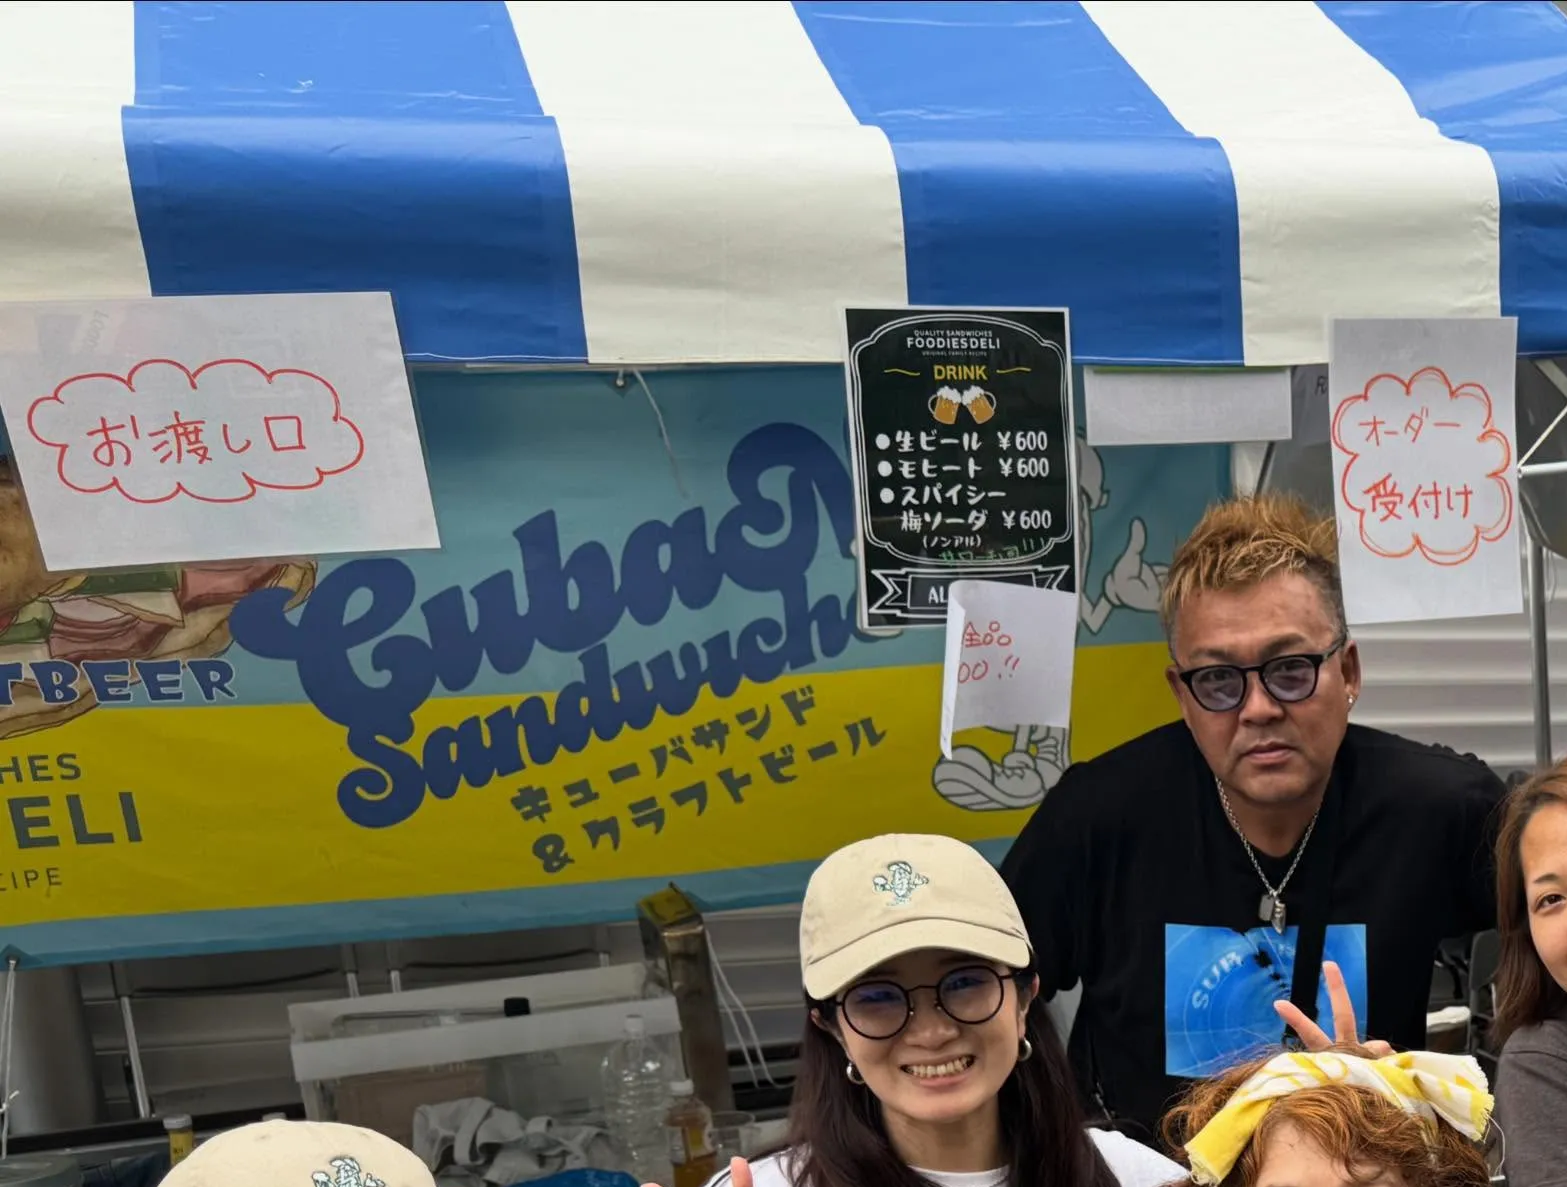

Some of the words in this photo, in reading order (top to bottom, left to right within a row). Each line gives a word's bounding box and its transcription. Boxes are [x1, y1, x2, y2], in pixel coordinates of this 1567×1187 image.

[907, 337, 1000, 349] FOODIESDELI
[934, 365, 988, 380] DRINK
[86, 411, 306, 466] お渡し口
[895, 429, 982, 453] 生ビール
[997, 431, 1048, 451] ¥600
[1358, 406, 1460, 446] オーダー
[898, 457, 982, 479] モヒート
[999, 457, 1050, 478] ¥600
[901, 483, 1006, 506] スパイシー
[1362, 472, 1473, 522] 受付け
[900, 509, 988, 533] 梅ソーダ
[1002, 510, 1052, 530] ¥600
[337, 563, 868, 829] Sandwich
[510, 685, 816, 822] キューバサンド
[582, 717, 888, 851] クラフトビール
